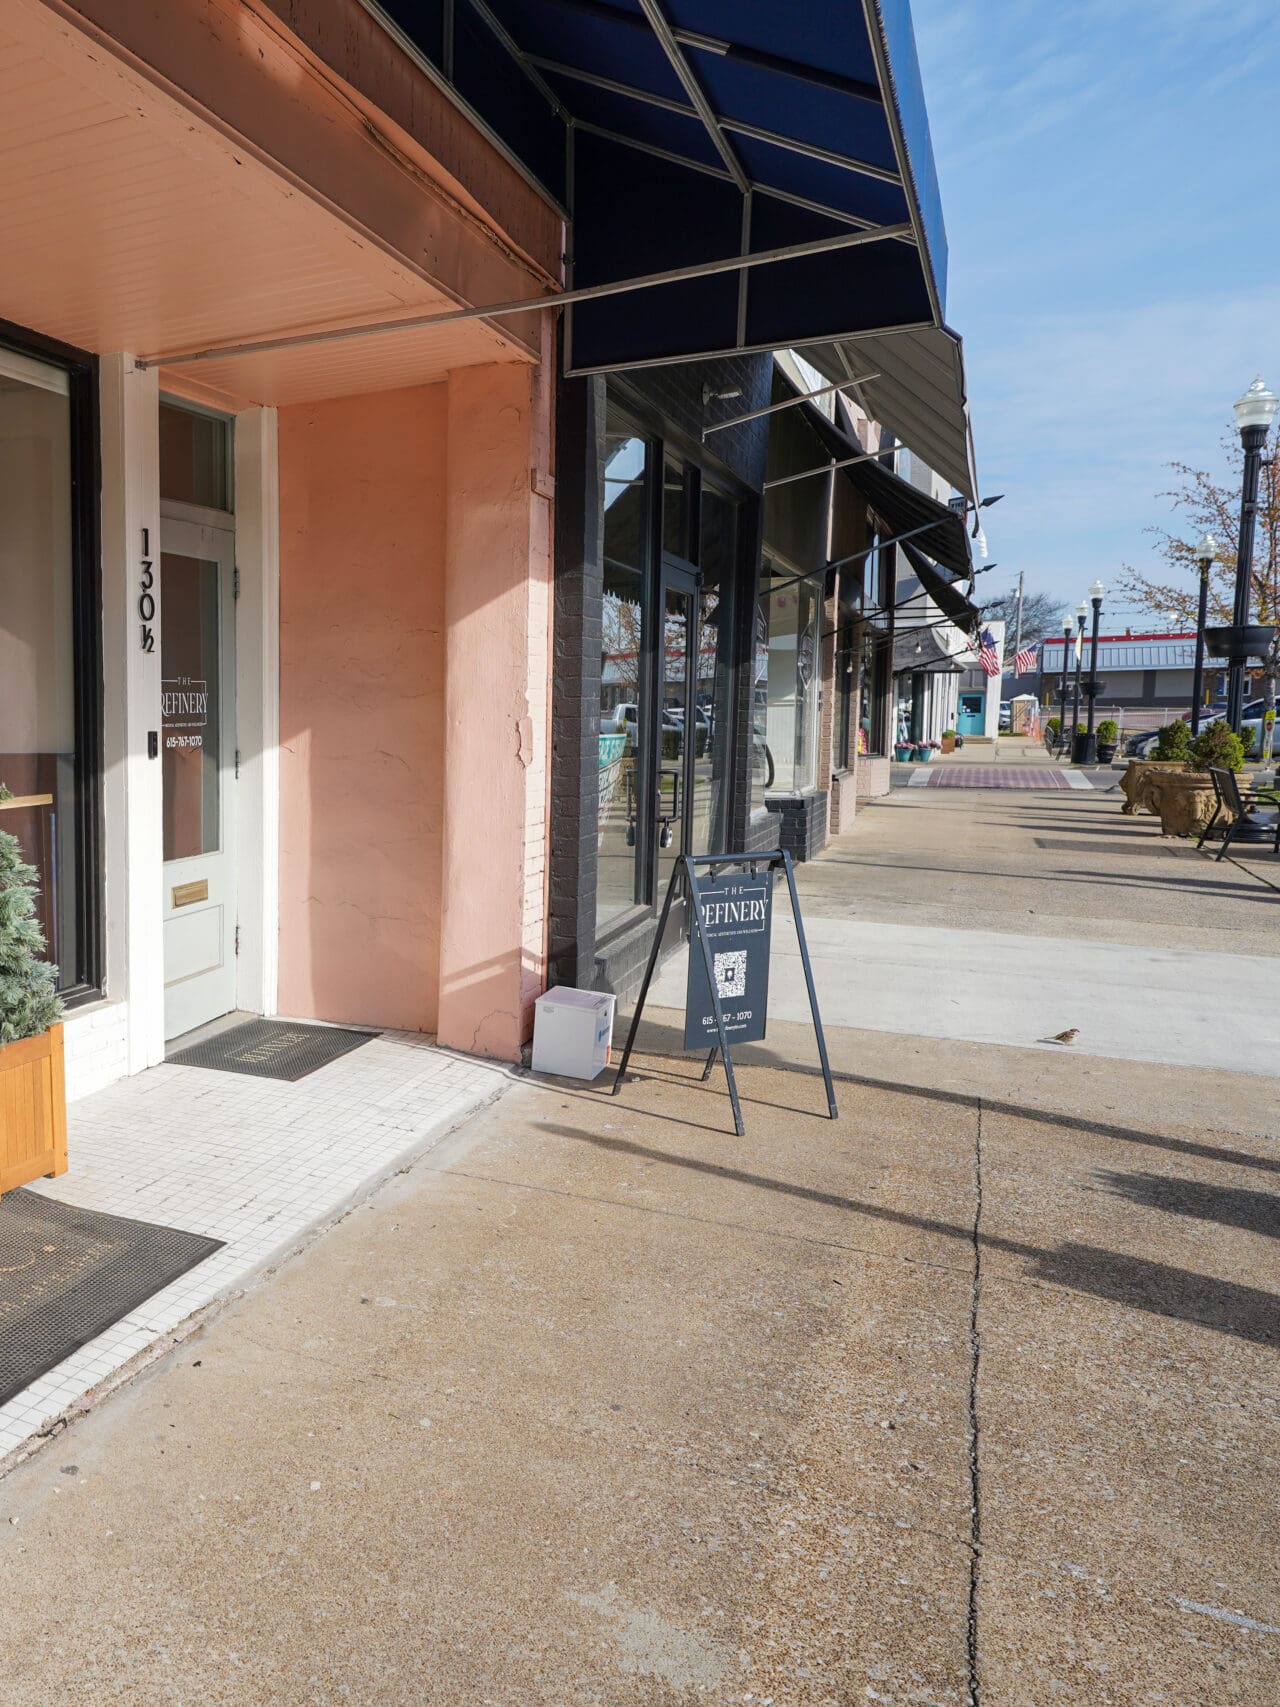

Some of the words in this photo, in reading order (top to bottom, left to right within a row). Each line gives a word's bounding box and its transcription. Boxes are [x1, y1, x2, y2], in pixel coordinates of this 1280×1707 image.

[177, 676, 192, 686] THE
[166, 736, 203, 748] 615-767-1070
[723, 886, 744, 896] THE
